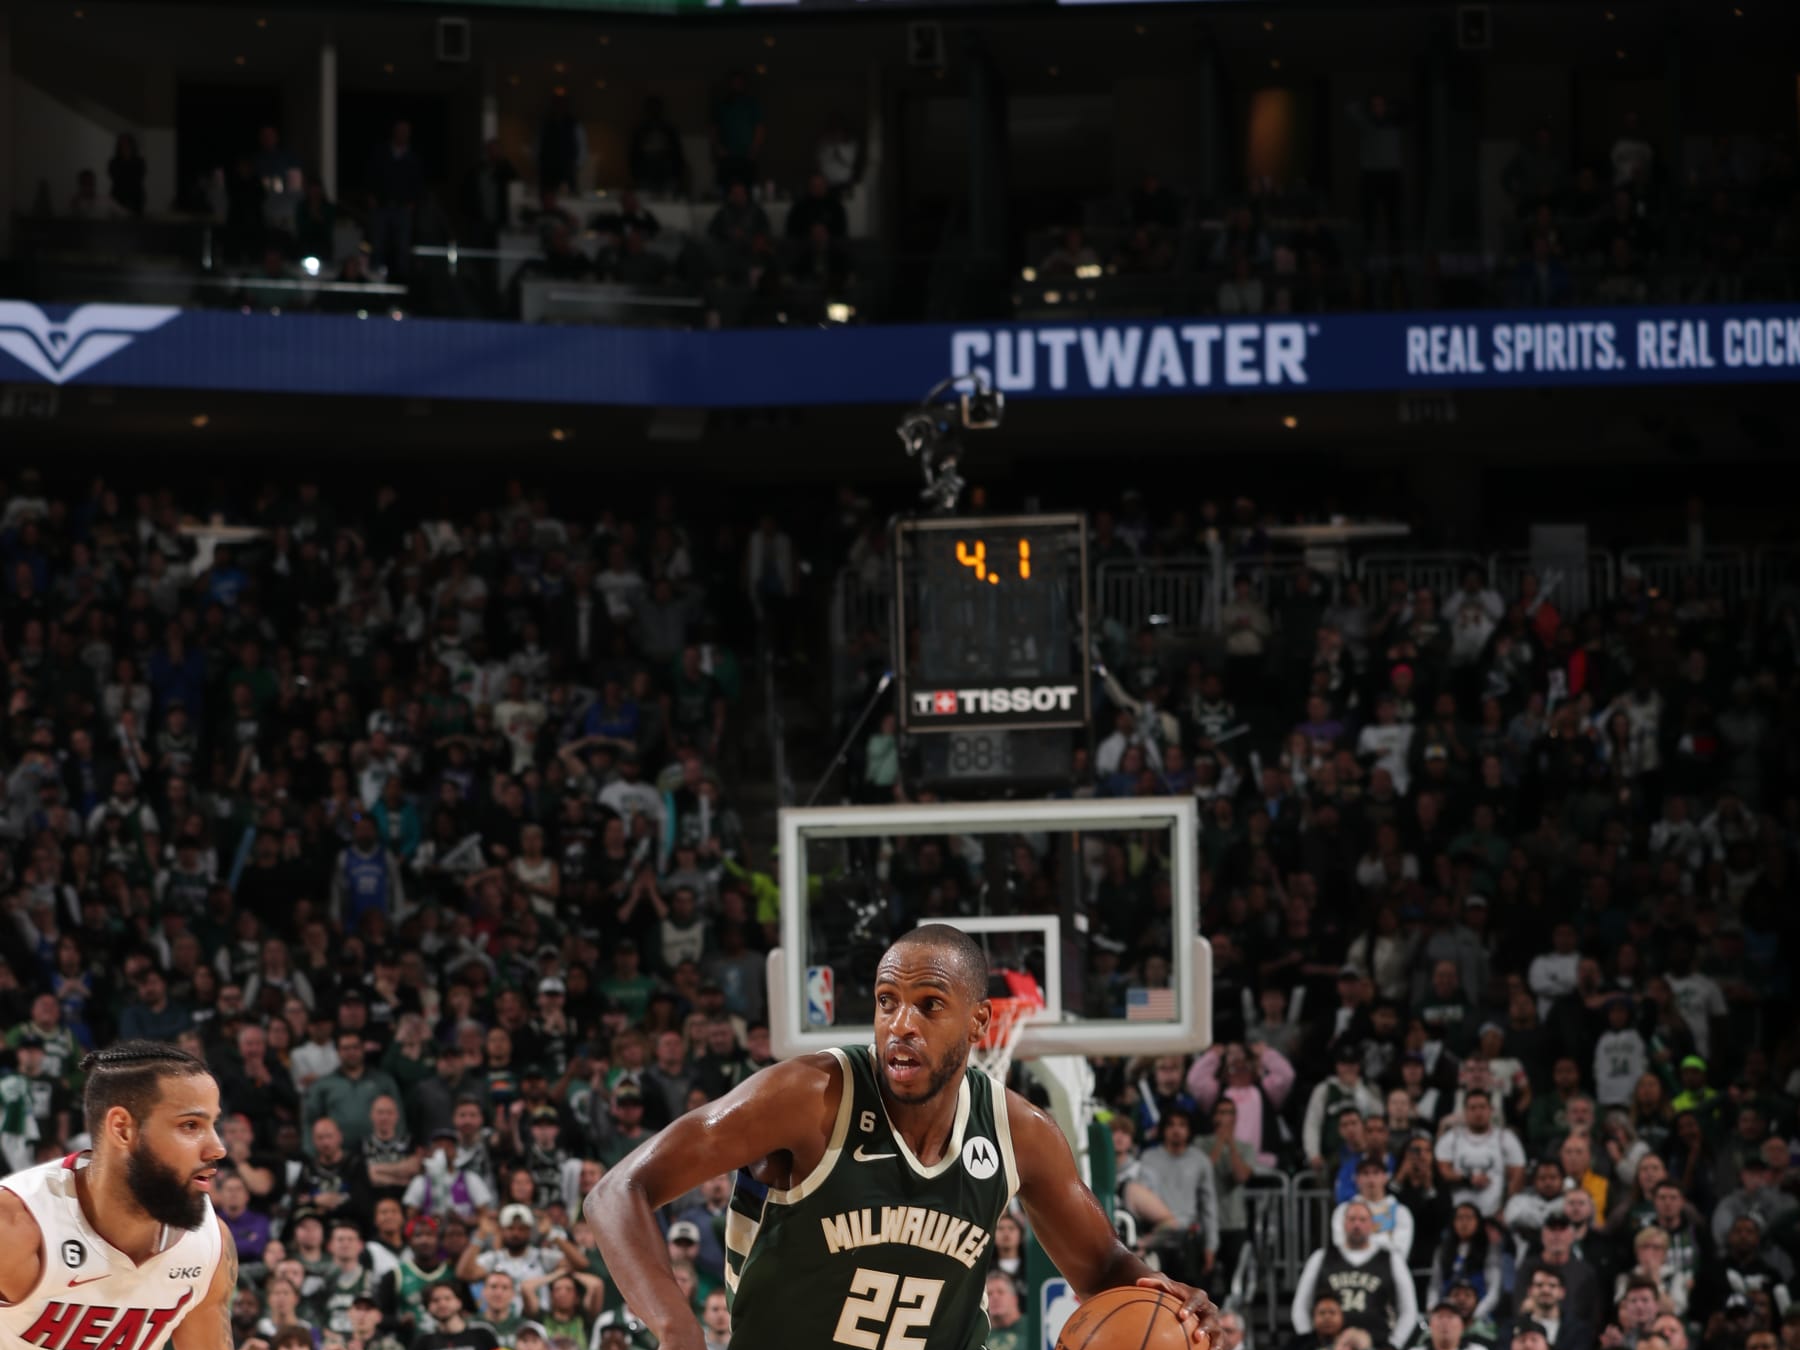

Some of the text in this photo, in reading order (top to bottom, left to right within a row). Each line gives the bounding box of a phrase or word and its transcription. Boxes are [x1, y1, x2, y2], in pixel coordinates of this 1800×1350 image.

[952, 323, 1309, 391] CUTWATER
[1406, 325, 1485, 374] REAL
[1492, 321, 1626, 373] SPIRITS.
[1636, 319, 1716, 368] REAL
[955, 538, 1031, 585] 4.1
[957, 686, 1078, 714] TISSOT
[858, 1110, 876, 1134] 6
[66, 1242, 82, 1265] 6
[820, 1205, 991, 1270] MILWAUKEE
[1340, 1288, 1366, 1312] 34
